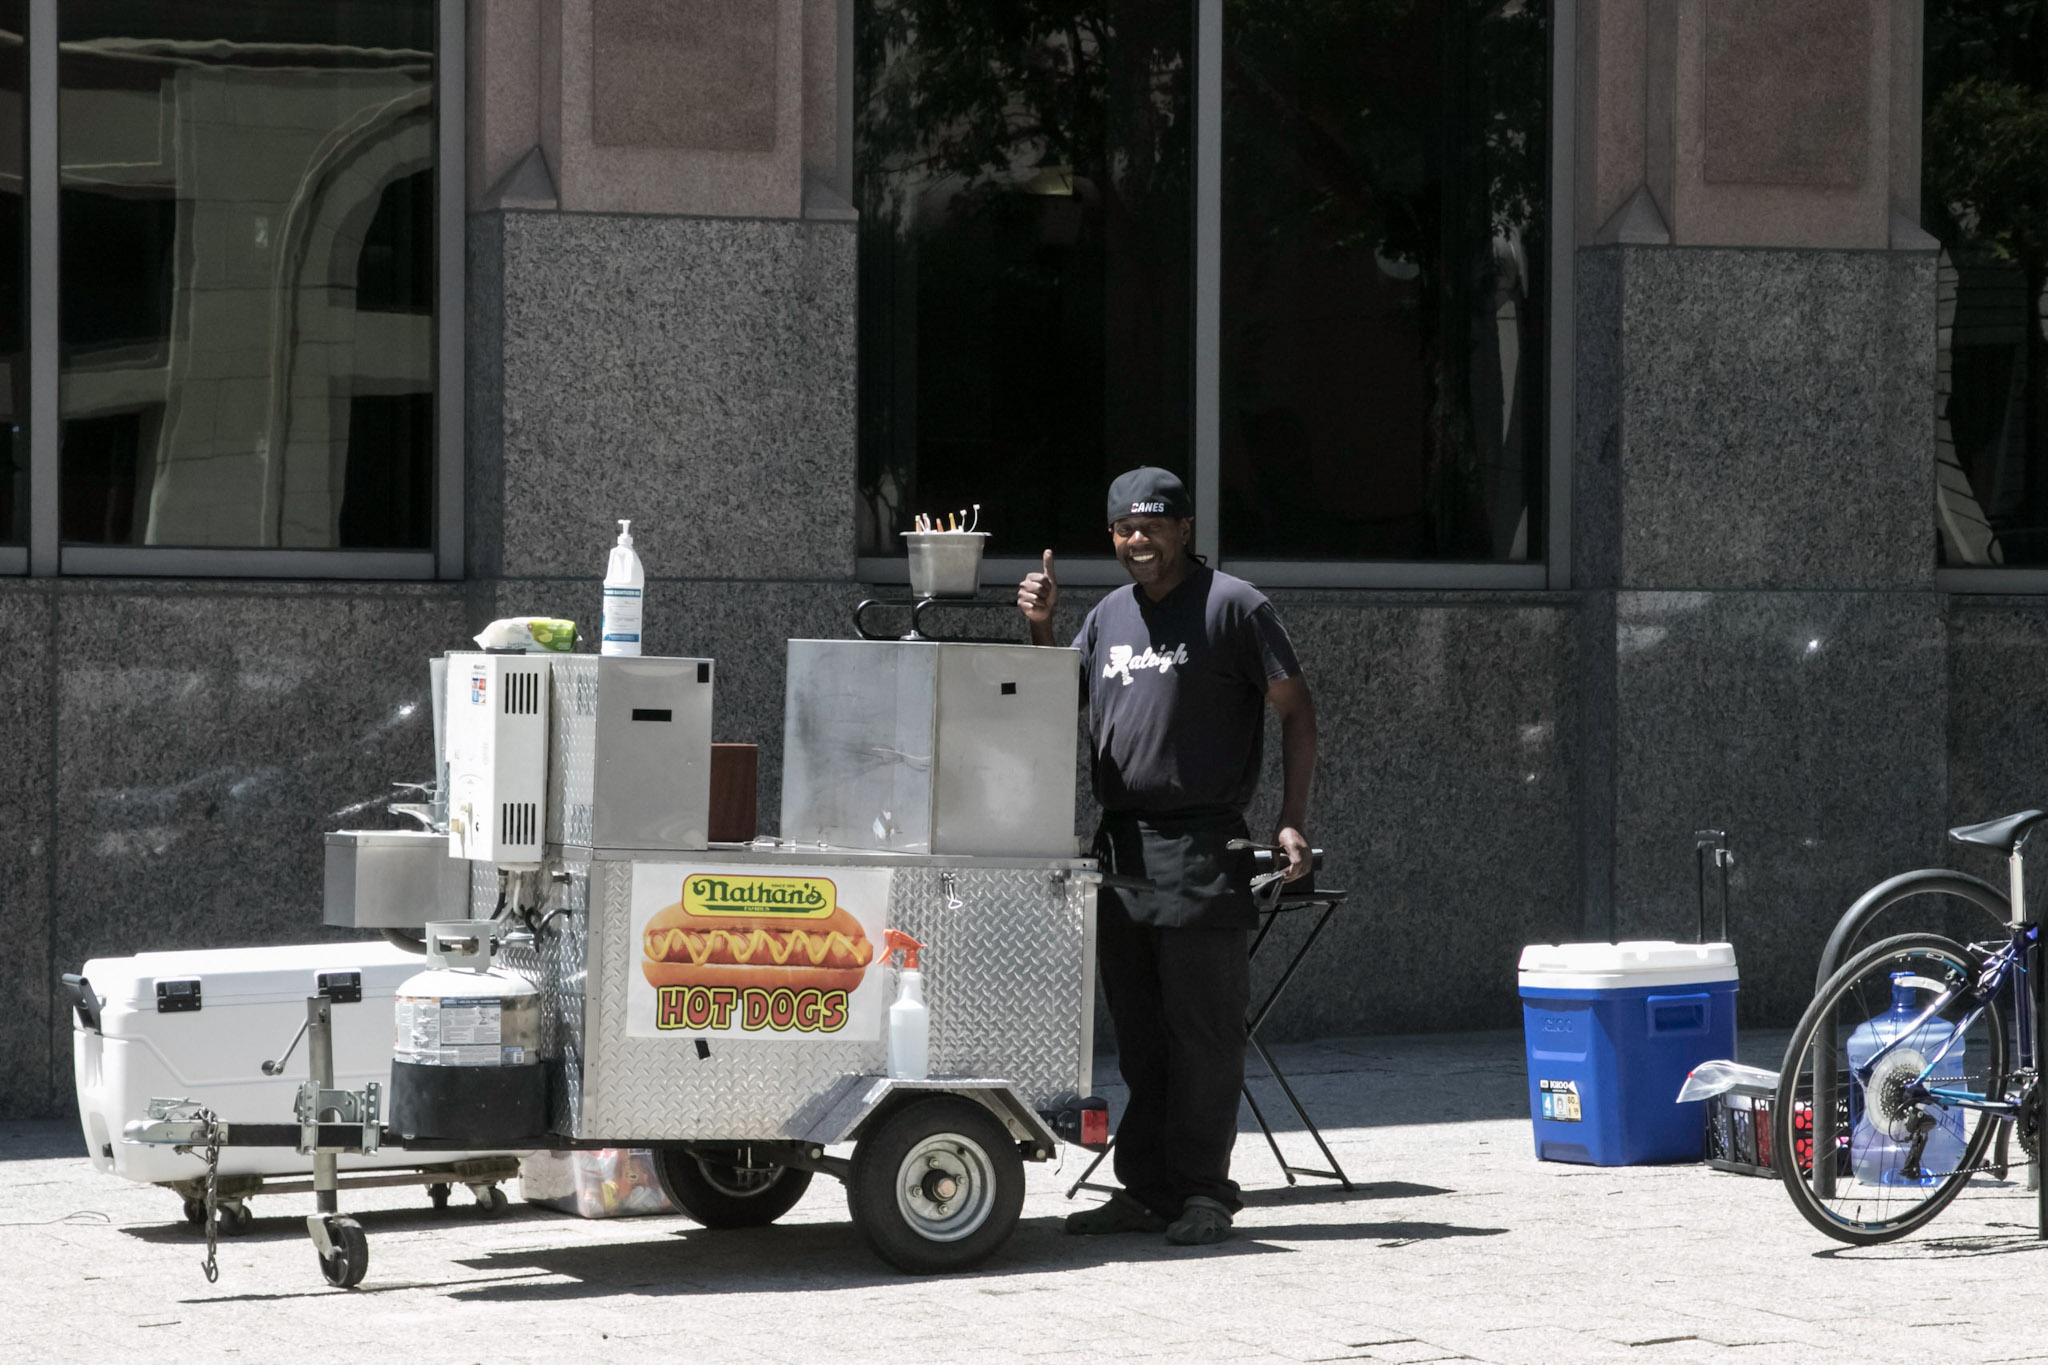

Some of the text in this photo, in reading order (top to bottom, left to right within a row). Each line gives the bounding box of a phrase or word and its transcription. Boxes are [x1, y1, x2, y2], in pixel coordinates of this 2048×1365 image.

[1130, 502, 1164, 512] CANES
[1102, 643, 1188, 686] Raleigh
[692, 879, 824, 905] Nathan's
[656, 985, 849, 1033] HOT DOGS
